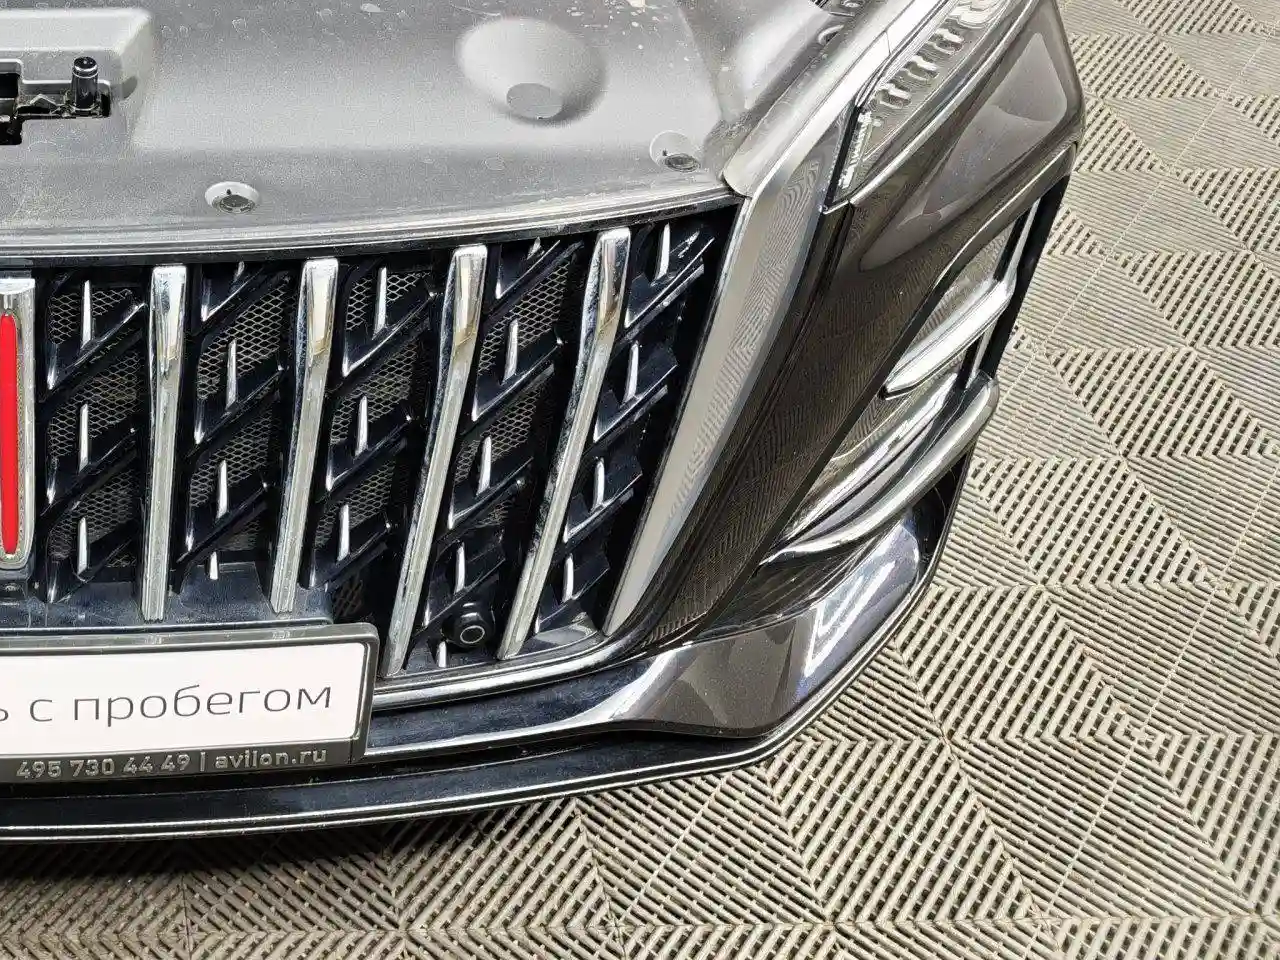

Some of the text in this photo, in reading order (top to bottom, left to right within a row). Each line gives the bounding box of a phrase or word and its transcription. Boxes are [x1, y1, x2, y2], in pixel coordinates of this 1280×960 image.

[29, 698, 53, 723] с
[74, 684, 332, 727] пробегом
[16, 759, 62, 780] 495
[69, 757, 115, 778] 730
[122, 755, 154, 775] 44
[160, 753, 191, 772] 49
[214, 749, 328, 770] avilon.ru
